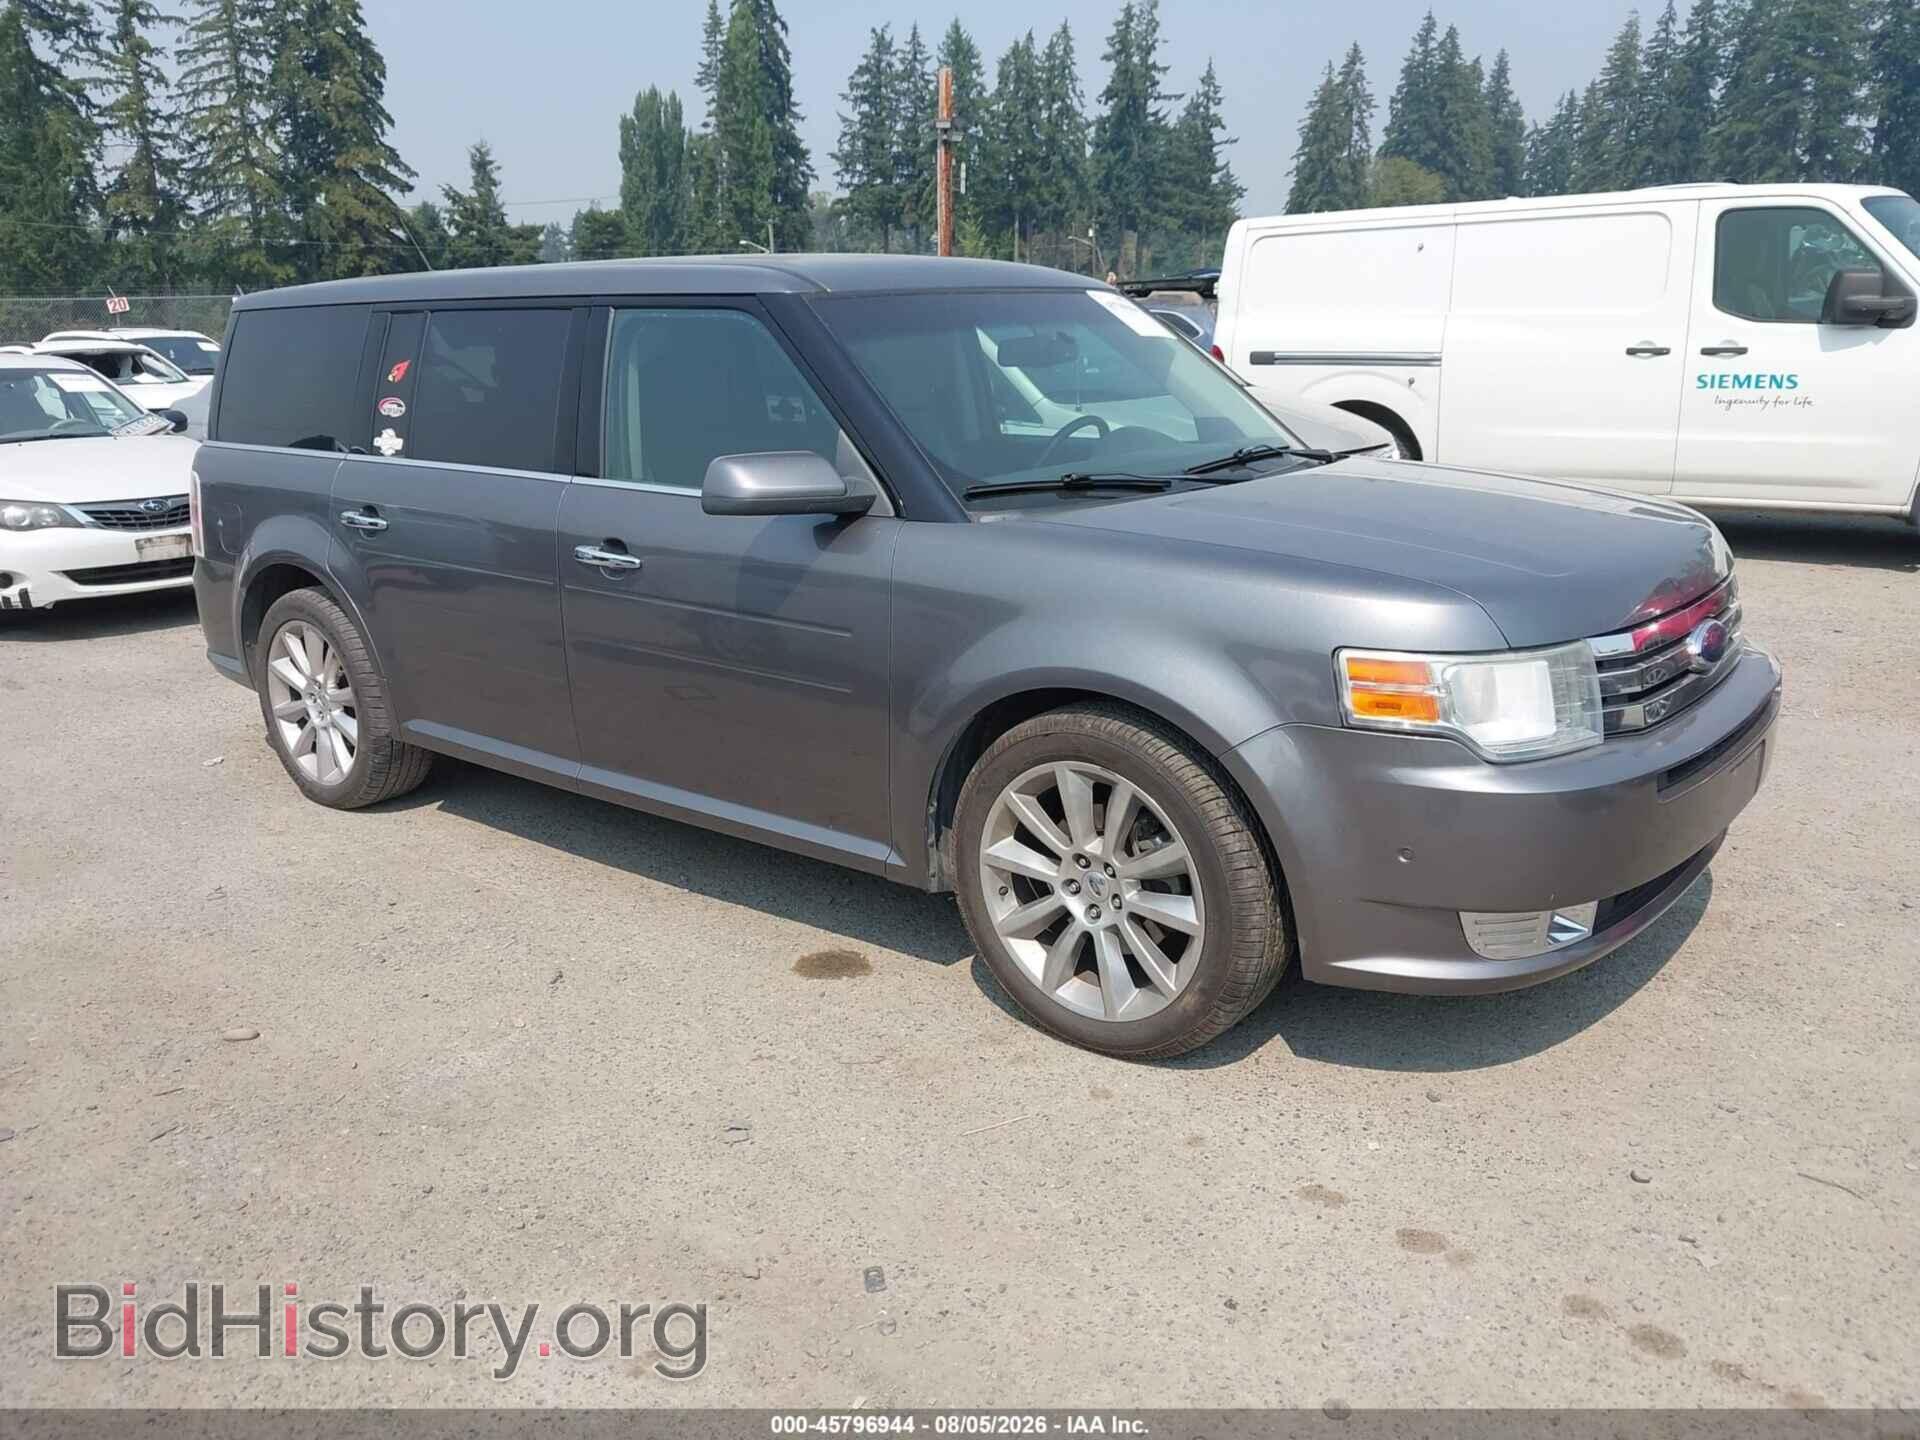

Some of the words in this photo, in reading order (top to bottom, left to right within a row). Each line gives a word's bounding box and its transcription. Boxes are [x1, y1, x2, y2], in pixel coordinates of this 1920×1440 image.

[109, 299, 127, 311] 20
[1696, 374, 1799, 389] SIEMENS
[1714, 395, 1770, 411] Ingenuity
[1771, 395, 1790, 408] for
